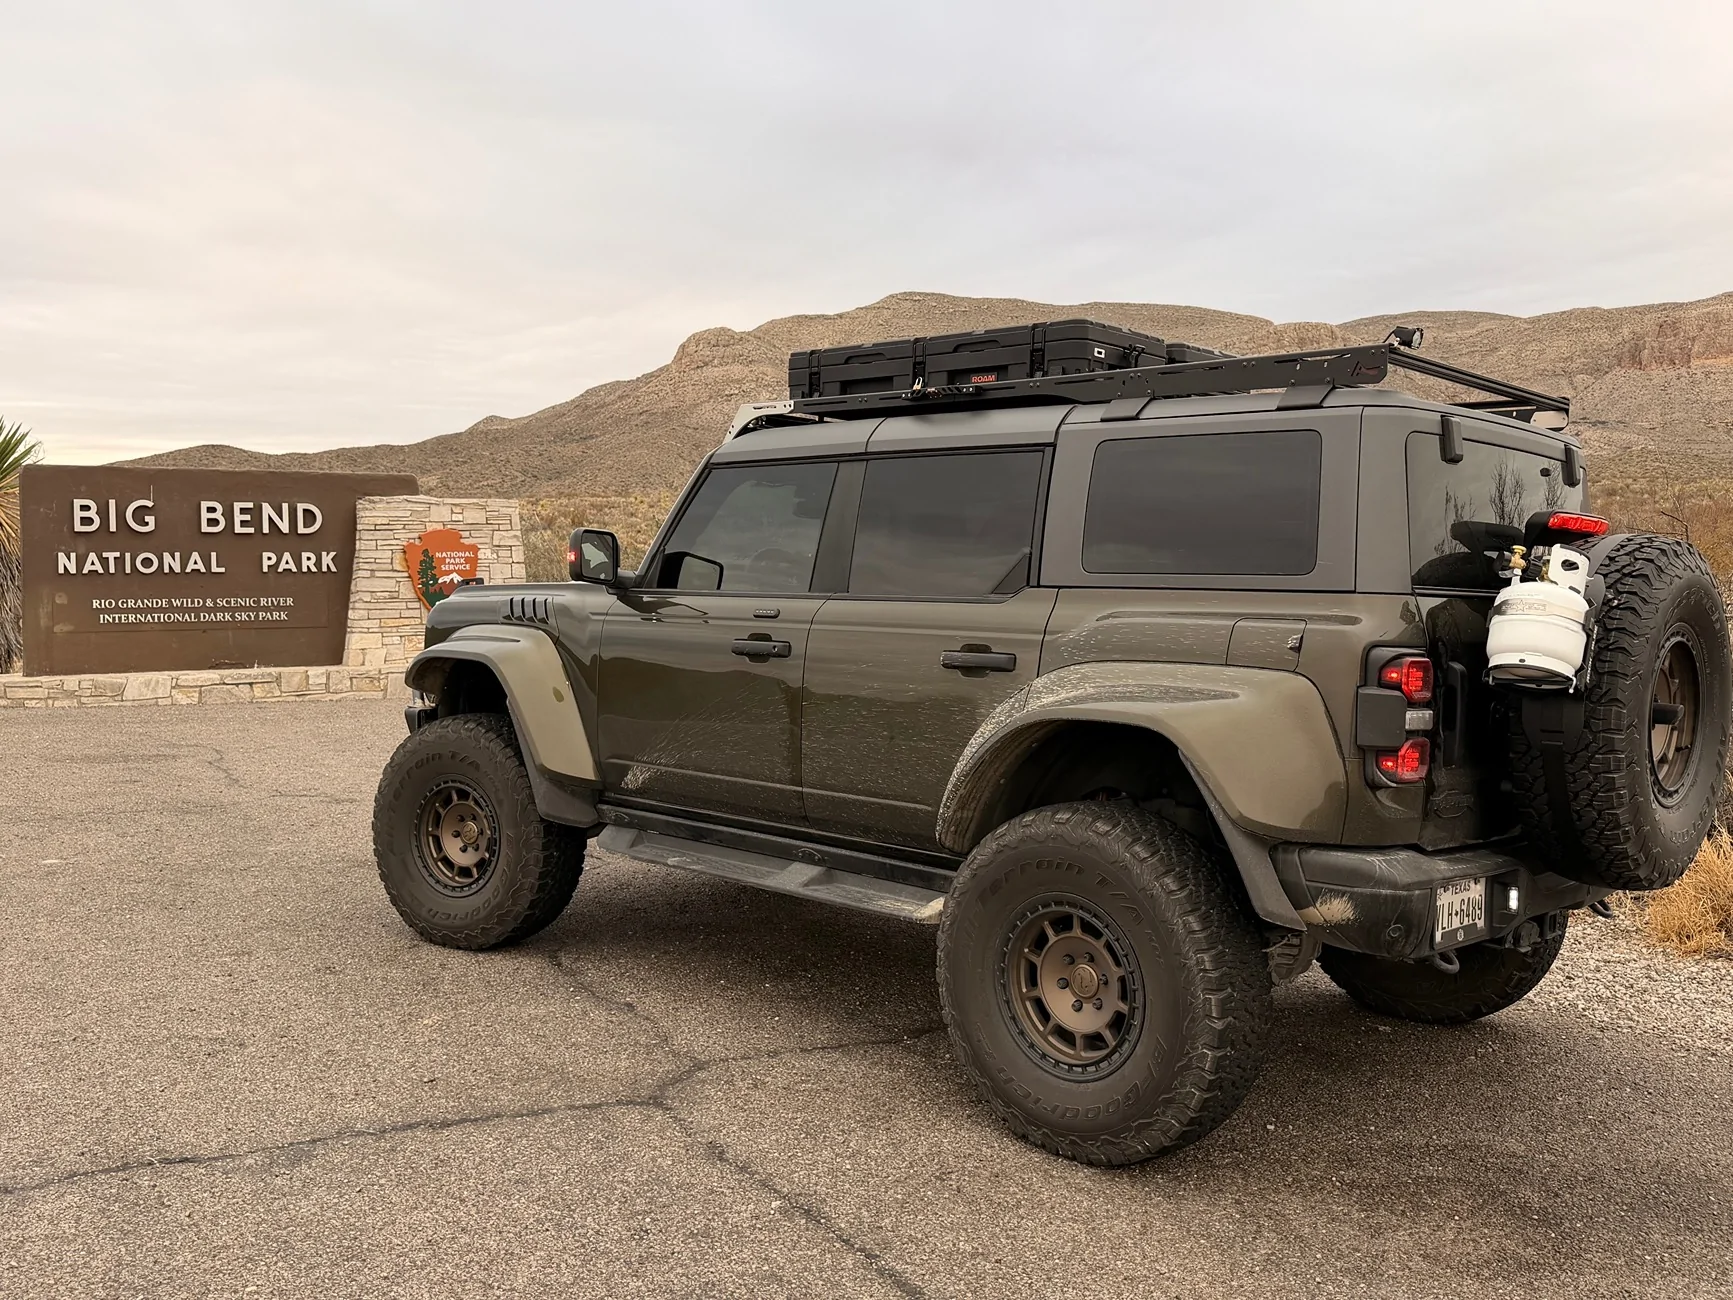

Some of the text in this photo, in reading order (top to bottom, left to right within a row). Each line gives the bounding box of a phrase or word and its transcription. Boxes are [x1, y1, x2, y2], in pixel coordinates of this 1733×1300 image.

[971, 375, 995, 383] ROAM
[73, 499, 323, 534] BIG BEND
[57, 551, 338, 574] NATIONAL PARK
[92, 597, 294, 609] RIO GRANDE WILD & SCENIC RIVER
[99, 611, 289, 624] INTERNATIONAL DARK SKY PARK
[1450, 880, 1471, 896] TEXAS
